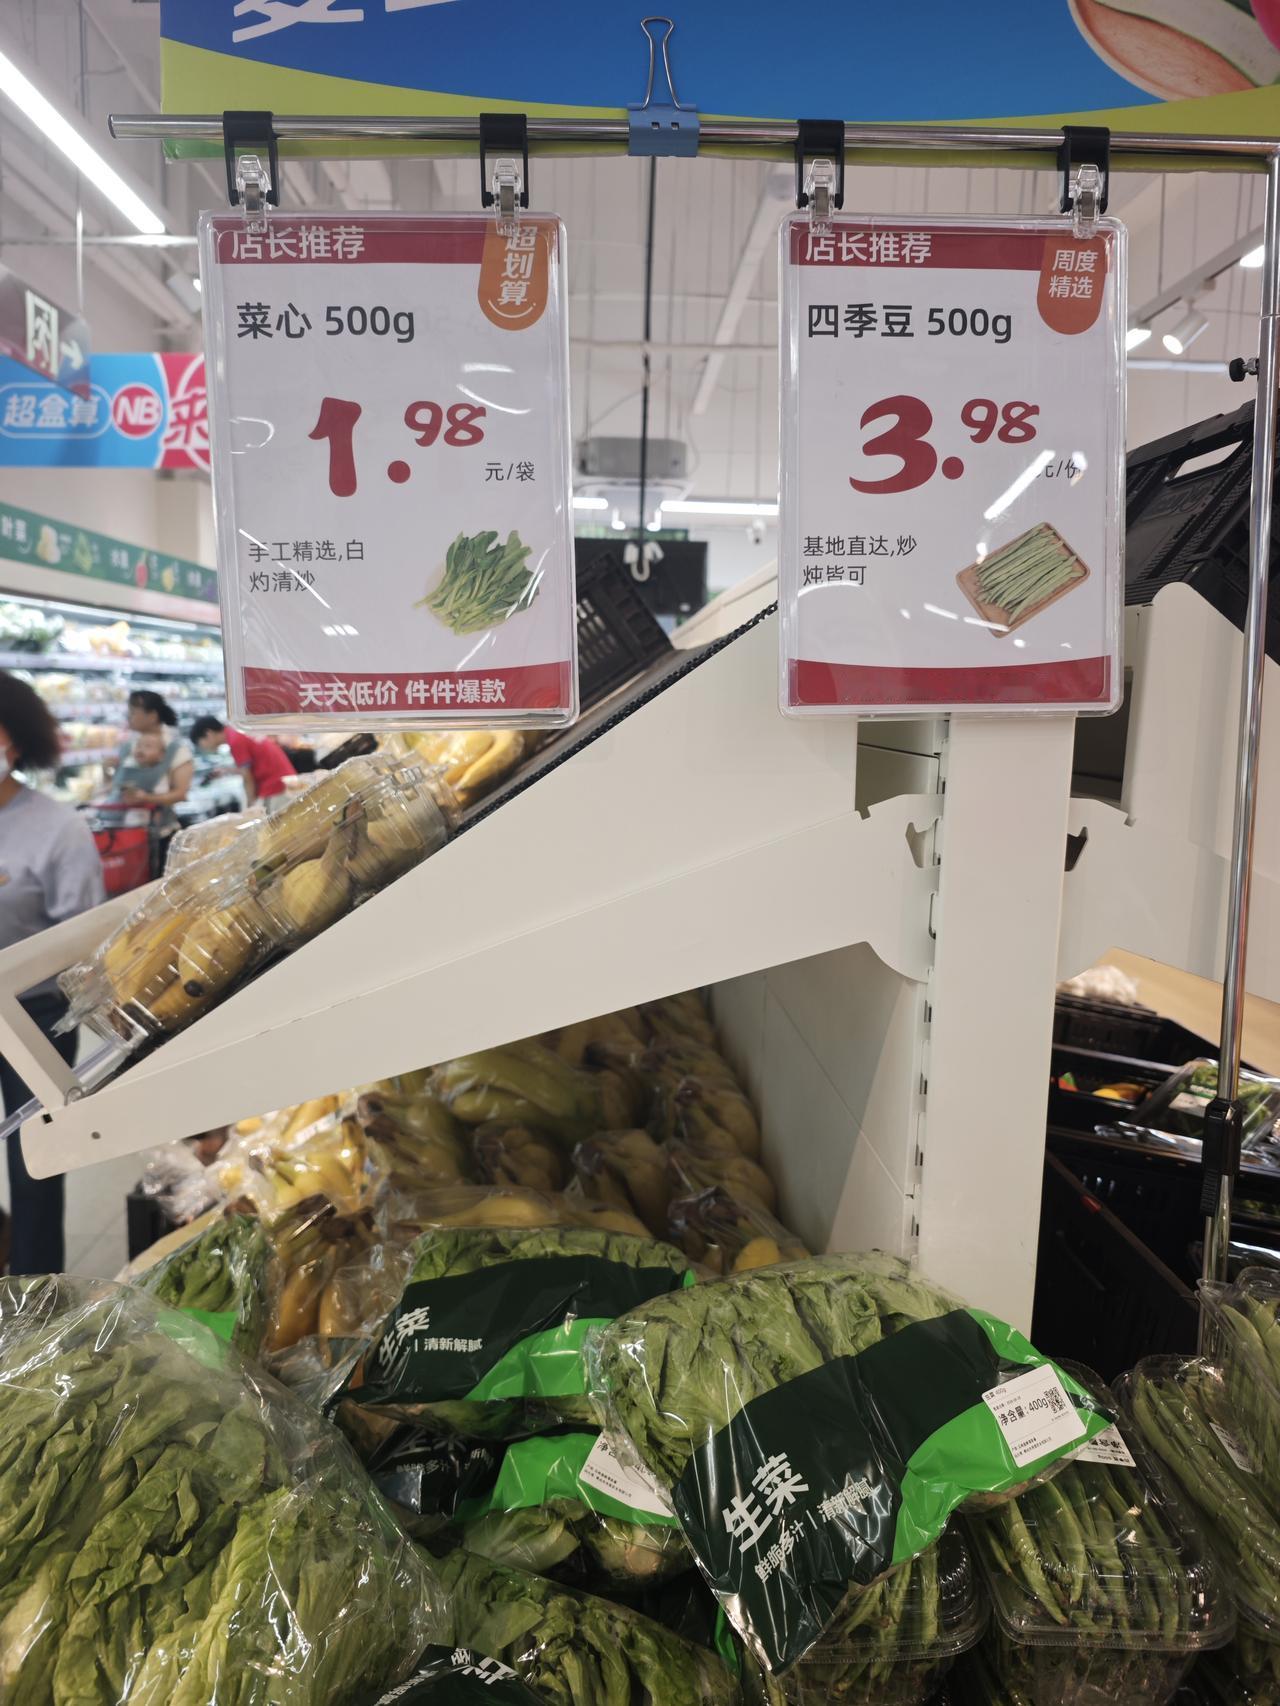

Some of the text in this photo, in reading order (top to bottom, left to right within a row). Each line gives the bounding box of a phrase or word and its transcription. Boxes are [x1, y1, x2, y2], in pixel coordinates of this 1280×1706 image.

[231, 226, 365, 260] 店长推荐
[805, 231, 932, 264] 店长推荐
[497, 226, 538, 306] 超划算
[1052, 250, 1098, 273] 周度
[1049, 276, 1094, 299] 精选
[237, 302, 415, 343] 菜心 500g
[808, 303, 1012, 344] 四季豆 500g
[115, 395, 160, 427] NB
[308, 397, 487, 497] 1.98
[849, 395, 1040, 495] 3.98
[485, 461, 536, 483] 元/袋
[248, 539, 364, 563] 手工精选,白
[803, 534, 917, 558] 基地直达,炒
[250, 570, 315, 593] 灼清炒
[299, 678, 506, 707] 天天低价 件件爆款
[379, 1306, 430, 1378] 生菜
[719, 1450, 809, 1552] 生菜
